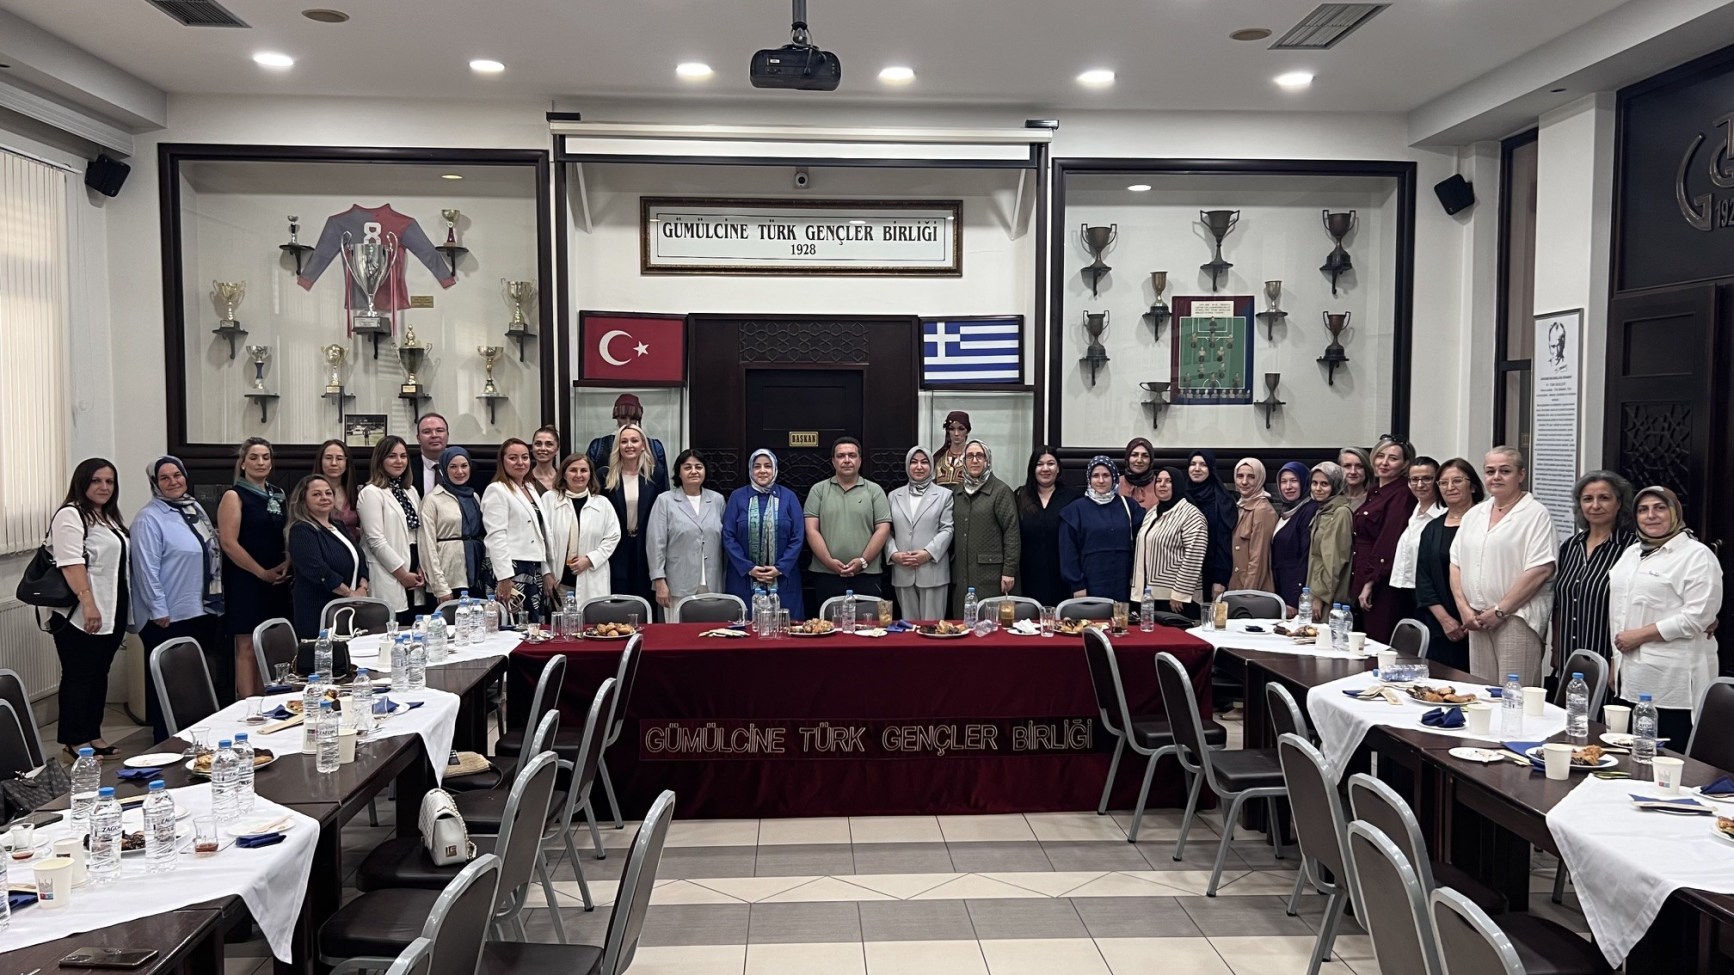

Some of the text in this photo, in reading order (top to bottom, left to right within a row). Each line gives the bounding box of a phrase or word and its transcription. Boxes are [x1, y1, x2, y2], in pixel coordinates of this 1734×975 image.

[363, 221, 382, 245] 8
[662, 217, 938, 246] GÜMÜLCİNE TÜRK GENÇLER BİRLİĞİ
[790, 243, 816, 256] 1928
[792, 435, 816, 445] BAŞKAN
[645, 719, 1092, 756] GÜMÜLCİNE TÜRK GENÇLER BİRLİĞİ
